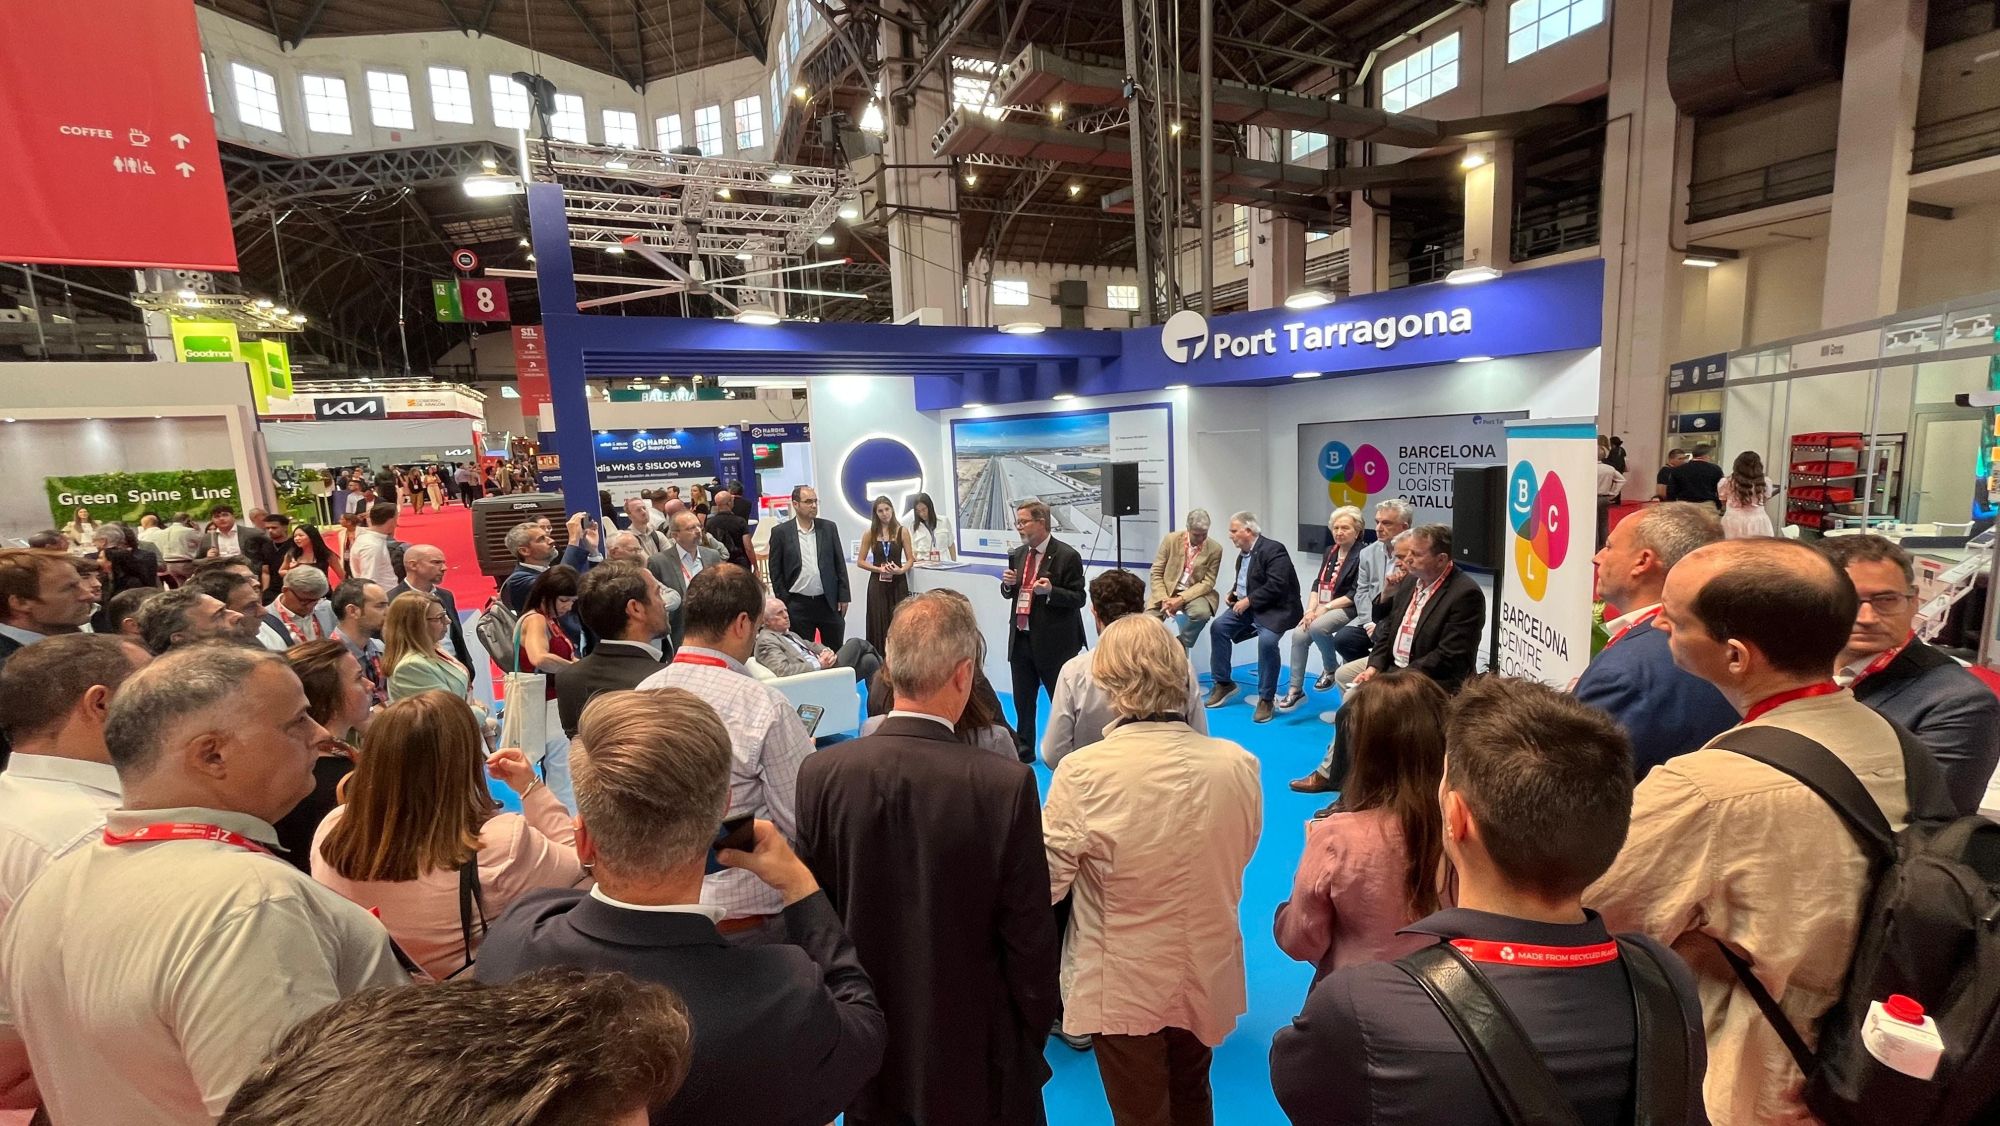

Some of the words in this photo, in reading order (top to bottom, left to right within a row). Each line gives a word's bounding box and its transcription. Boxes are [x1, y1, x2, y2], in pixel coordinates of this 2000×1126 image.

[60, 126, 113, 139] COFFEE
[476, 287, 495, 313] 8
[1214, 328, 1276, 359] Port
[1283, 307, 1472, 351] Tarragona
[1330, 451, 1340, 464] B
[1399, 444, 1496, 459] BARCELONA
[596, 463, 611, 472] dis
[612, 463, 636, 471] WMS
[645, 461, 678, 470] SISLOG
[679, 460, 701, 469] WMS
[1364, 461, 1375, 475] C
[1398, 462, 1457, 475] CENTRE
[58, 492, 118, 506] Green
[128, 489, 181, 504] Spine
[1343, 490, 1352, 503] L
[1518, 479, 1528, 502] B
[1548, 505, 1558, 533] C
[1527, 554, 1534, 580] L
[1503, 602, 1568, 662] BARCELONA
[1502, 627, 1542, 671] CENTRE
[1518, 951, 1543, 960] MADE
[1570, 952, 1600, 960] RECYCLED
